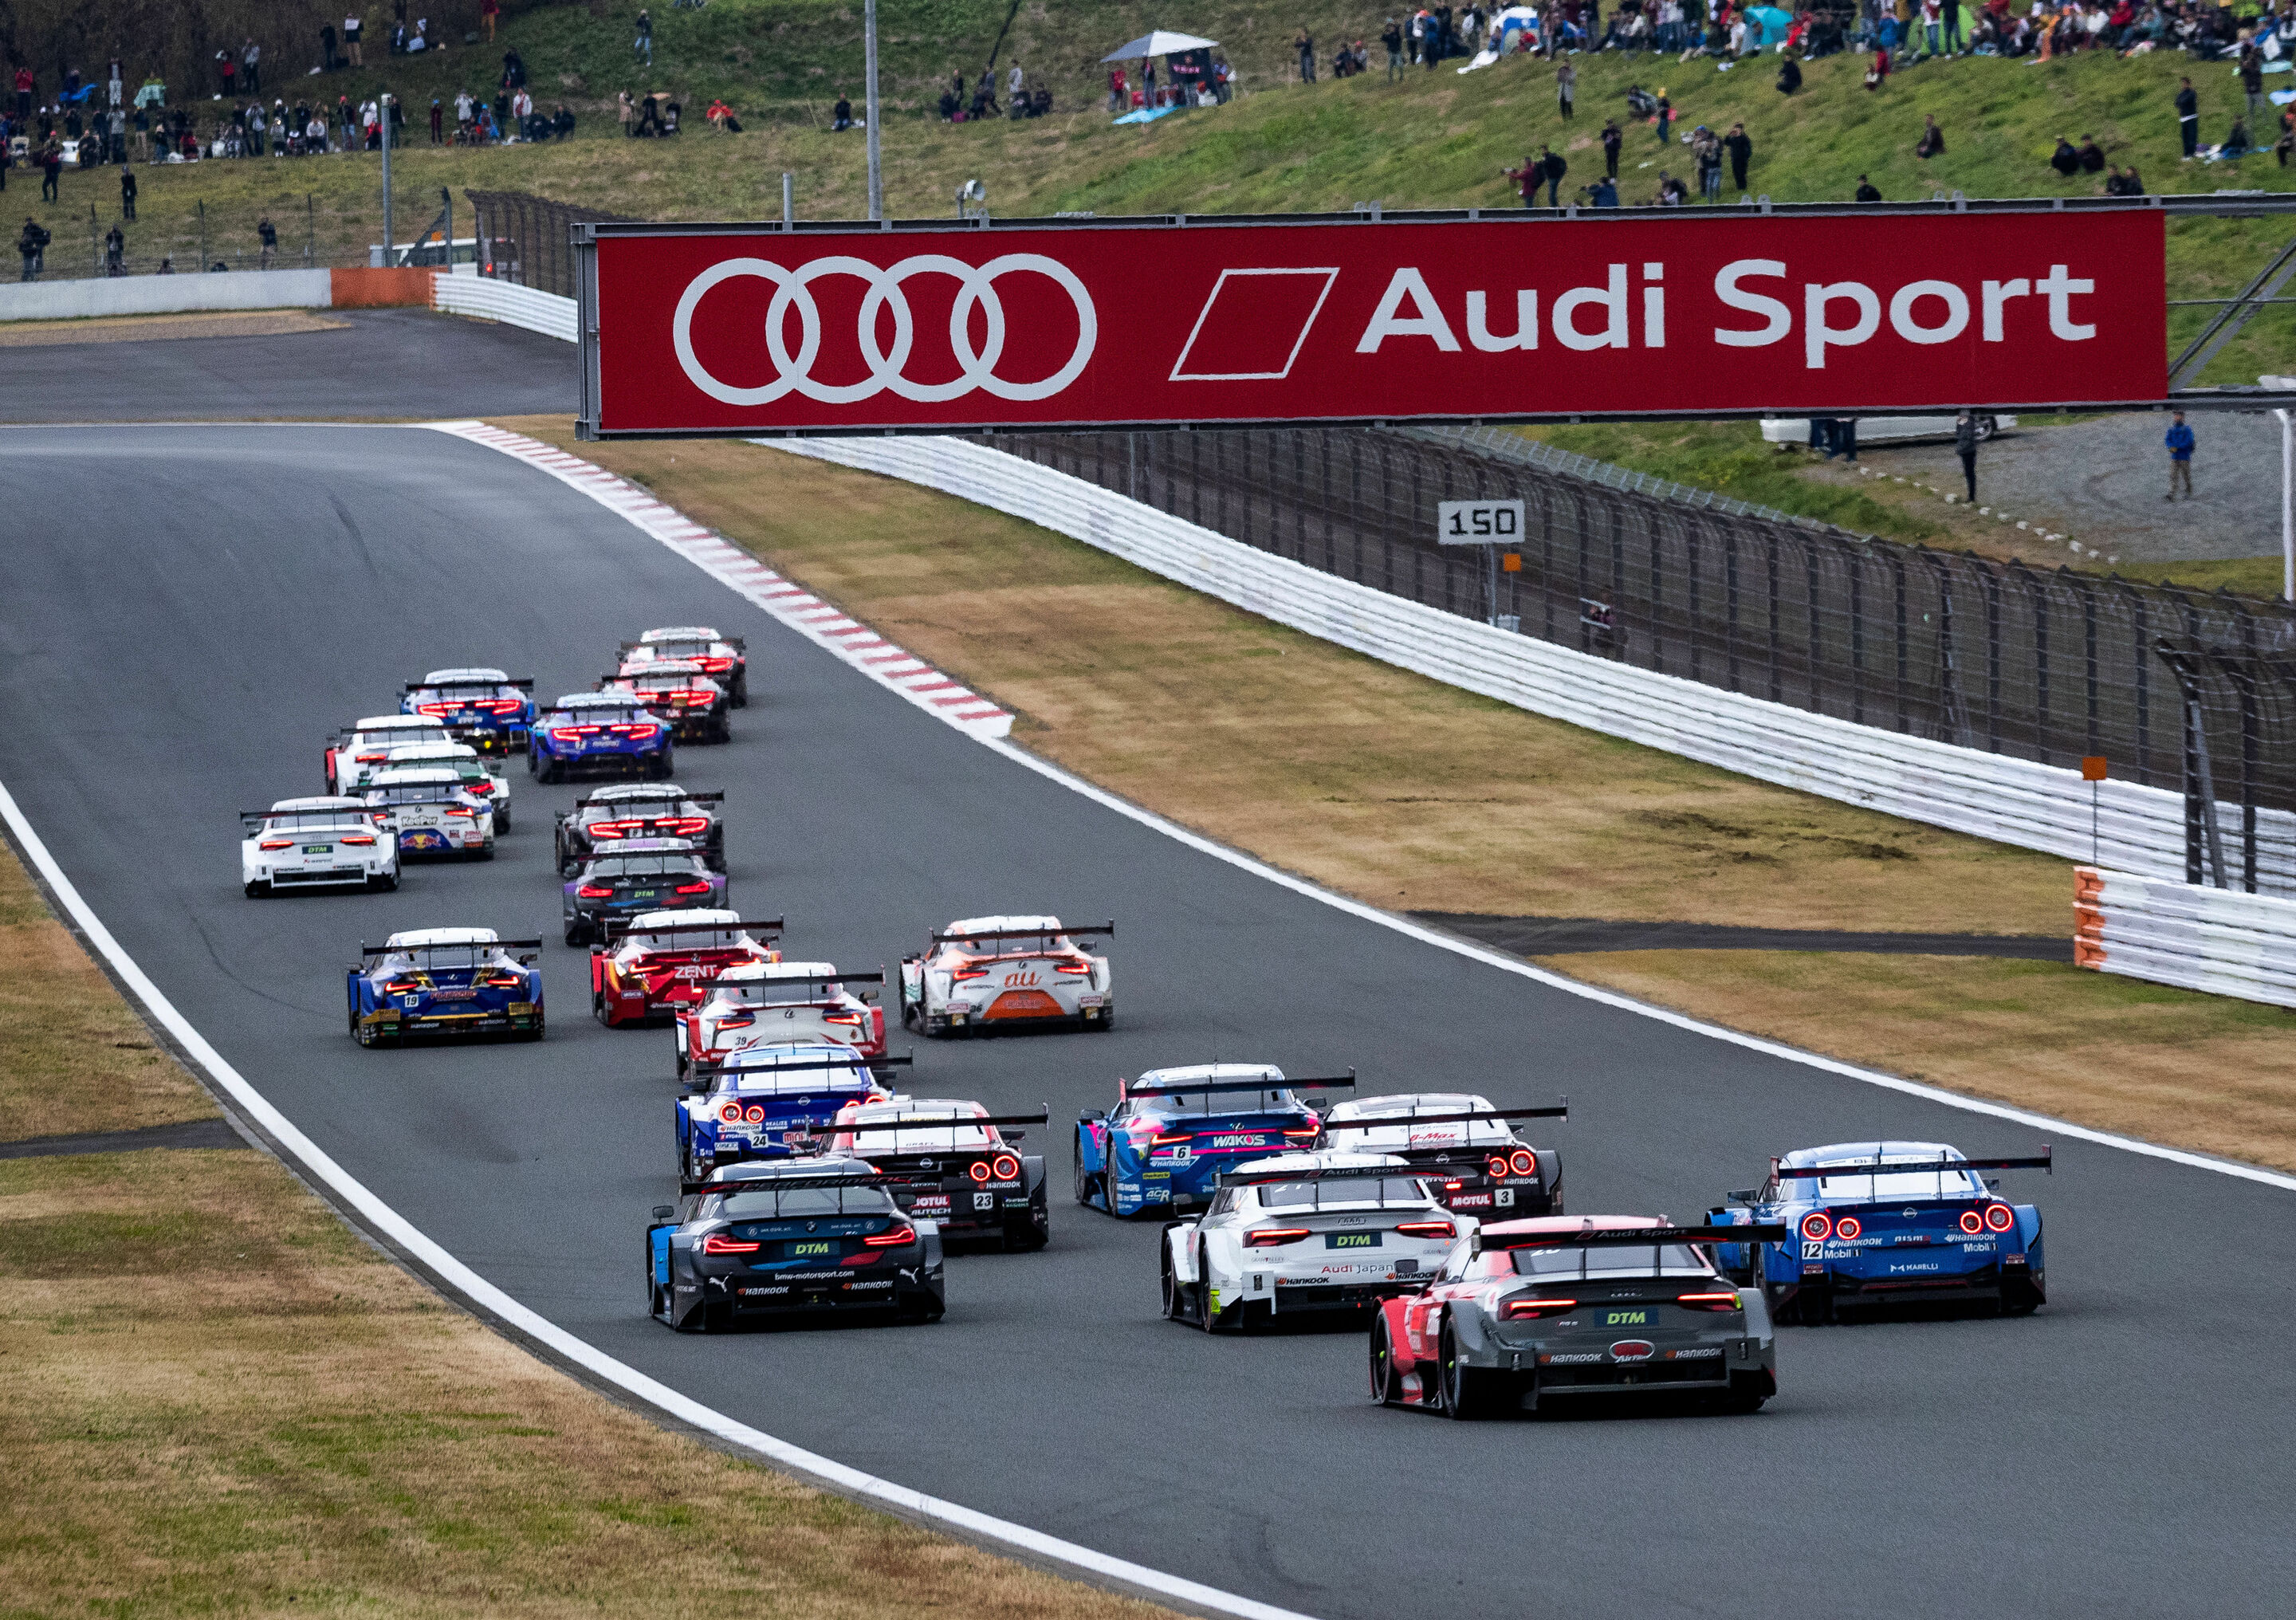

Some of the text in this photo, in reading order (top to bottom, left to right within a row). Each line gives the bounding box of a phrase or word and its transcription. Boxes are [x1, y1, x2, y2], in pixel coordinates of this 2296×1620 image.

[1355, 259, 2097, 369] Audi Sport
[1449, 508, 1516, 536] 150
[674, 964, 718, 980] ZENT
[1004, 970, 1043, 988] au
[407, 996, 418, 1006] 19
[735, 1036, 747, 1045] 39
[753, 1135, 767, 1146] 24
[1177, 1147, 1186, 1158] 6
[1362, 1166, 1405, 1175] Sport
[976, 1195, 992, 1207] 23
[1452, 1194, 1491, 1206] MOTUL
[1500, 1190, 1509, 1204] 3
[1598, 1229, 1689, 1239] Audi Sport
[1336, 1234, 1371, 1247] DTM
[795, 1243, 829, 1256] DTM
[1803, 1243, 1822, 1258] 12
[1964, 1243, 1990, 1252] Mobil
[1825, 1249, 1852, 1260] Mobil
[1321, 1263, 1395, 1275] Audi Japan
[774, 1270, 855, 1281] bmw-motorsport.com
[1606, 1311, 1646, 1325] DTM
